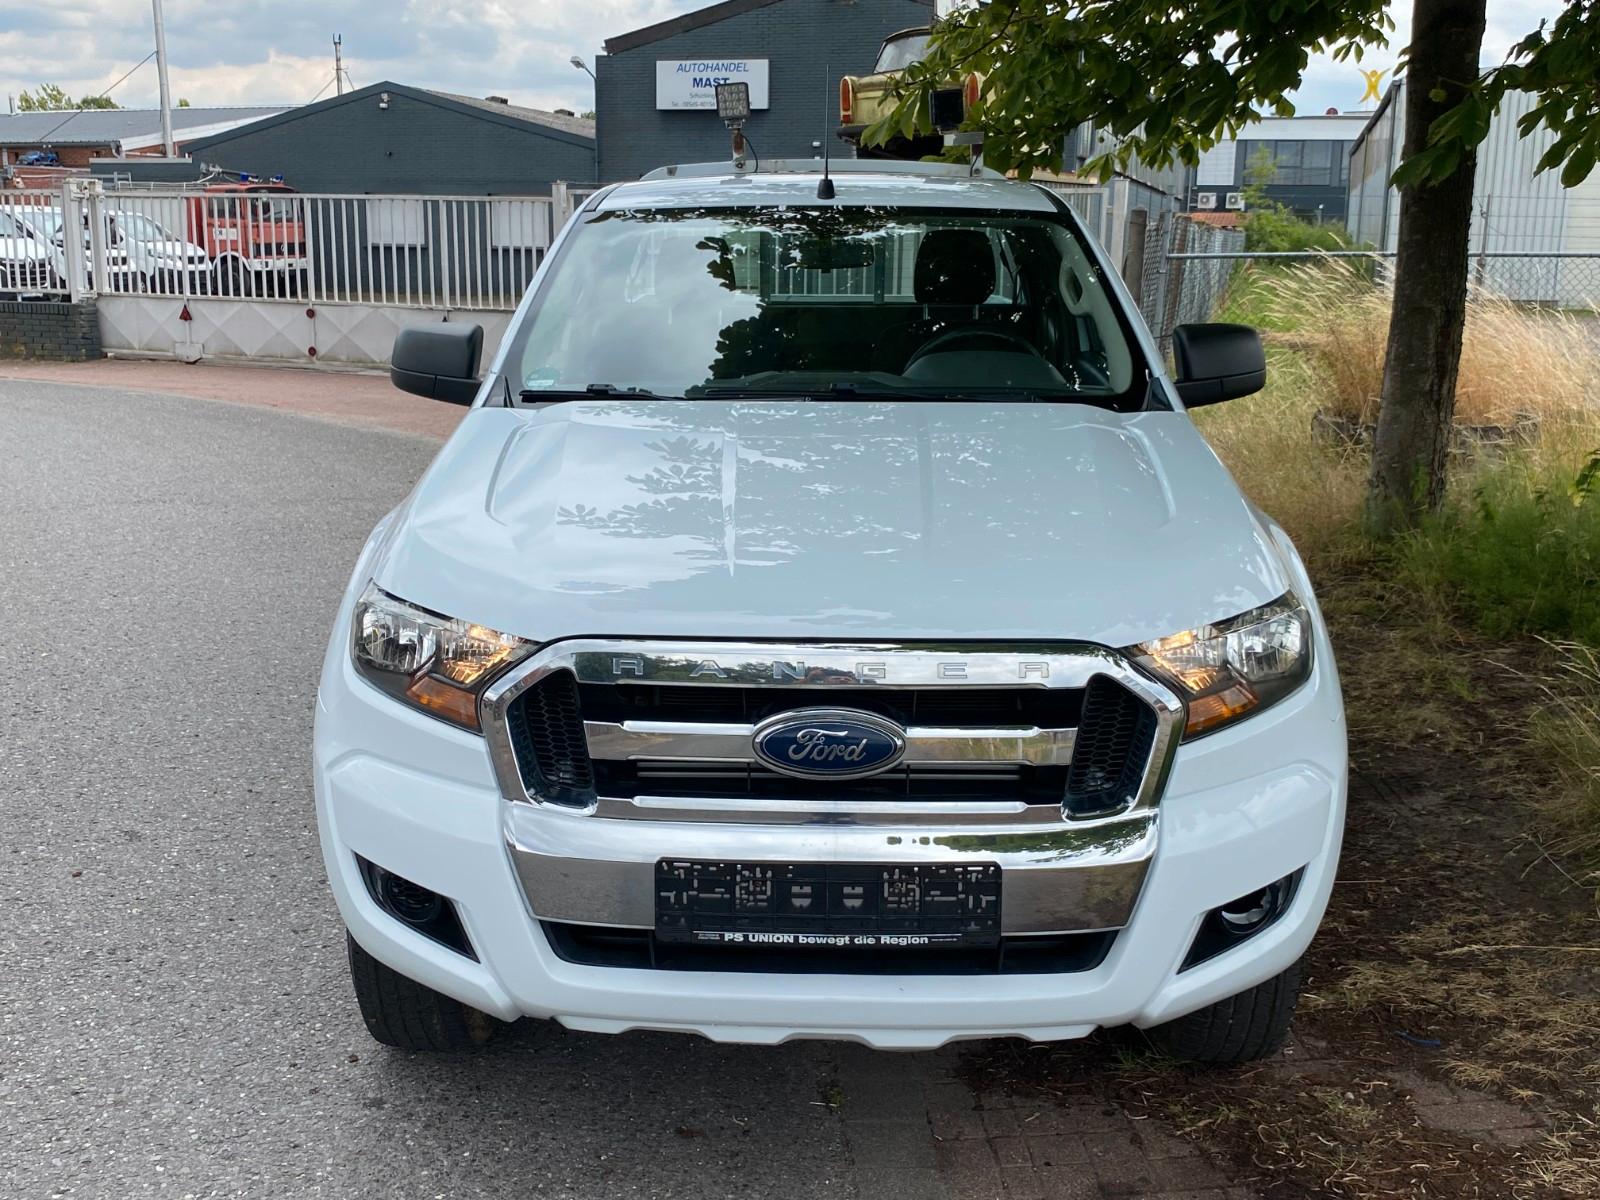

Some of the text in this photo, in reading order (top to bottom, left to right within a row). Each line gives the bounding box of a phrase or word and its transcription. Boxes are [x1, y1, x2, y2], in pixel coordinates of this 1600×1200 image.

[676, 62, 749, 73] AUTOHANDEL
[692, 77, 730, 89] MAST
[612, 657, 1050, 680] RANGER
[787, 728, 867, 761] Ford
[724, 933, 744, 942] PS
[748, 934, 794, 943] UNION
[799, 935, 850, 946] bewegt
[854, 935, 876, 944] die
[880, 935, 929, 946] Region
